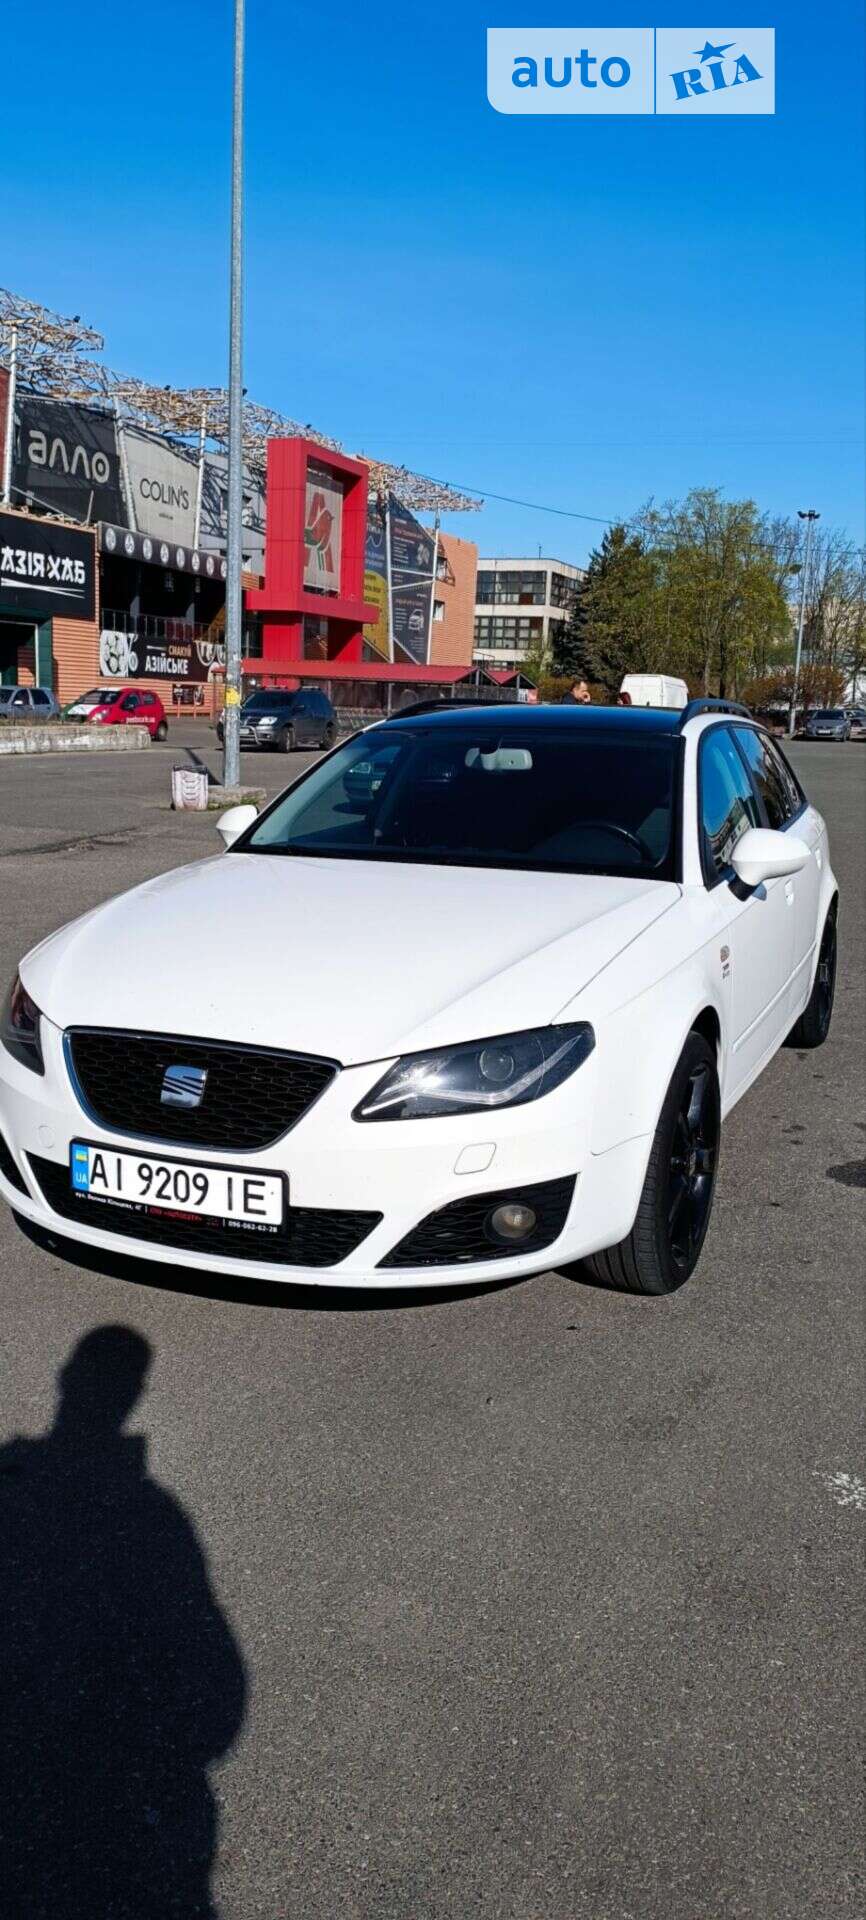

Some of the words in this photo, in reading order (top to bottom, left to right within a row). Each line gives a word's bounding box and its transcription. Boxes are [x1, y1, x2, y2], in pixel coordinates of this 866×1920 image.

[139, 478, 189, 511] COLIN'S
[145, 653, 189, 675] АЗІЙСЬКЕ
[75, 1172, 88, 1184] UA
[90, 1153, 122, 1191] AI
[137, 1163, 209, 1206] 9209
[227, 1177, 267, 1216] IE
